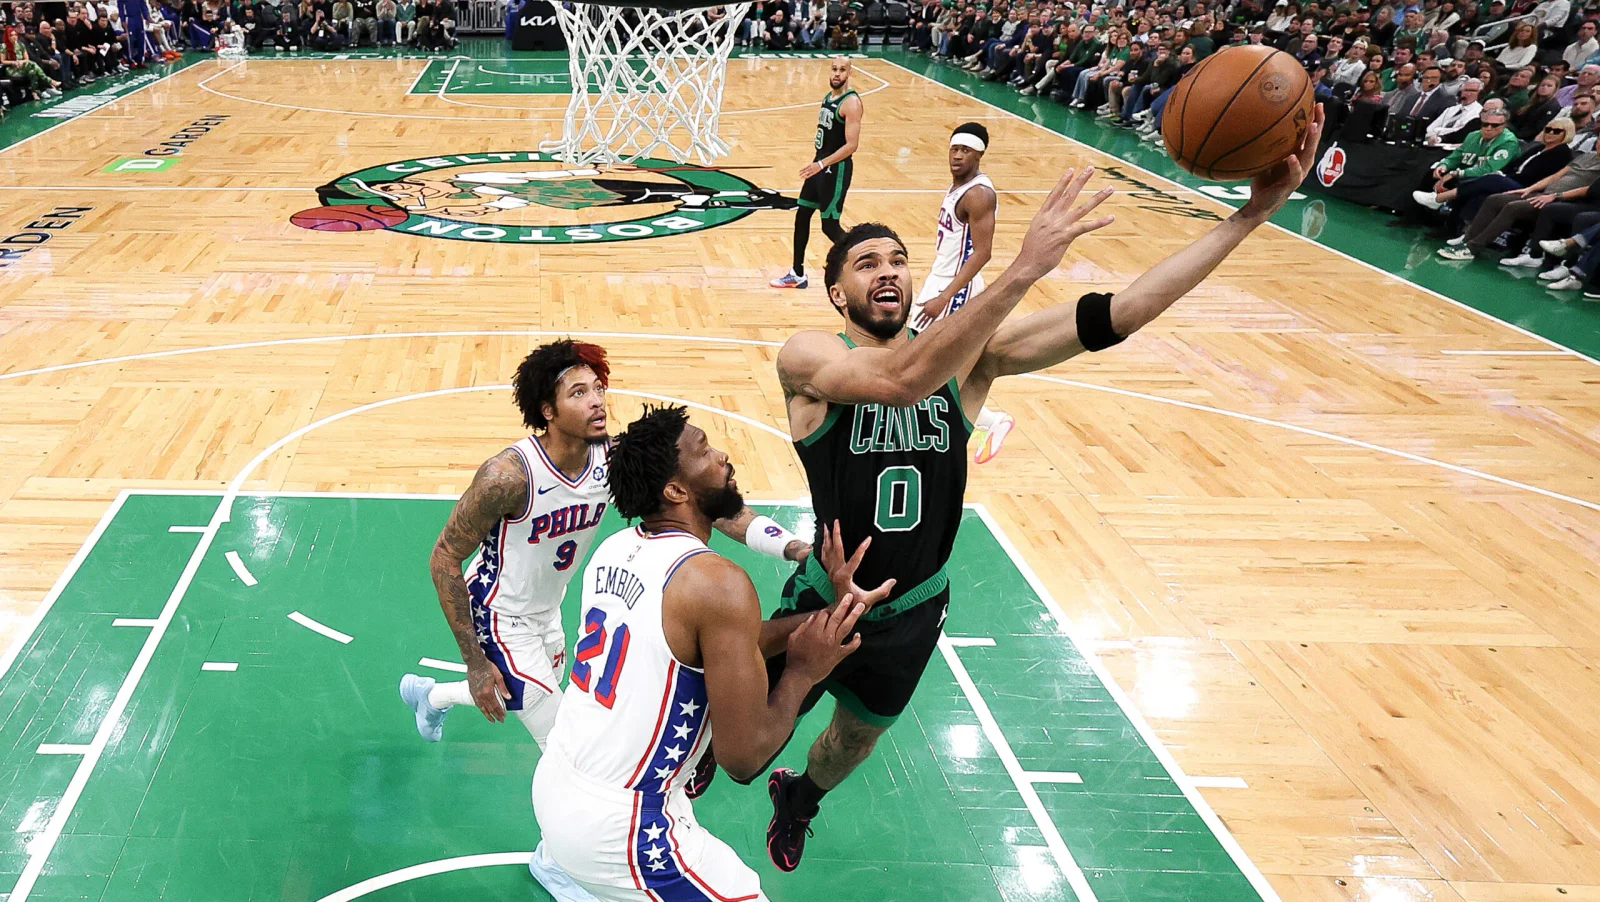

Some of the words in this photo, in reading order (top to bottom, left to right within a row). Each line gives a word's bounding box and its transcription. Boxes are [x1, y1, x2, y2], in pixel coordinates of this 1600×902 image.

[143, 114, 231, 156] GARDEN
[407, 215, 704, 241] BOSTON
[874, 465, 922, 532] 0
[764, 526, 783, 537] 9
[553, 540, 578, 571] 9
[595, 566, 645, 610] EMBIID
[570, 607, 631, 710] 21
